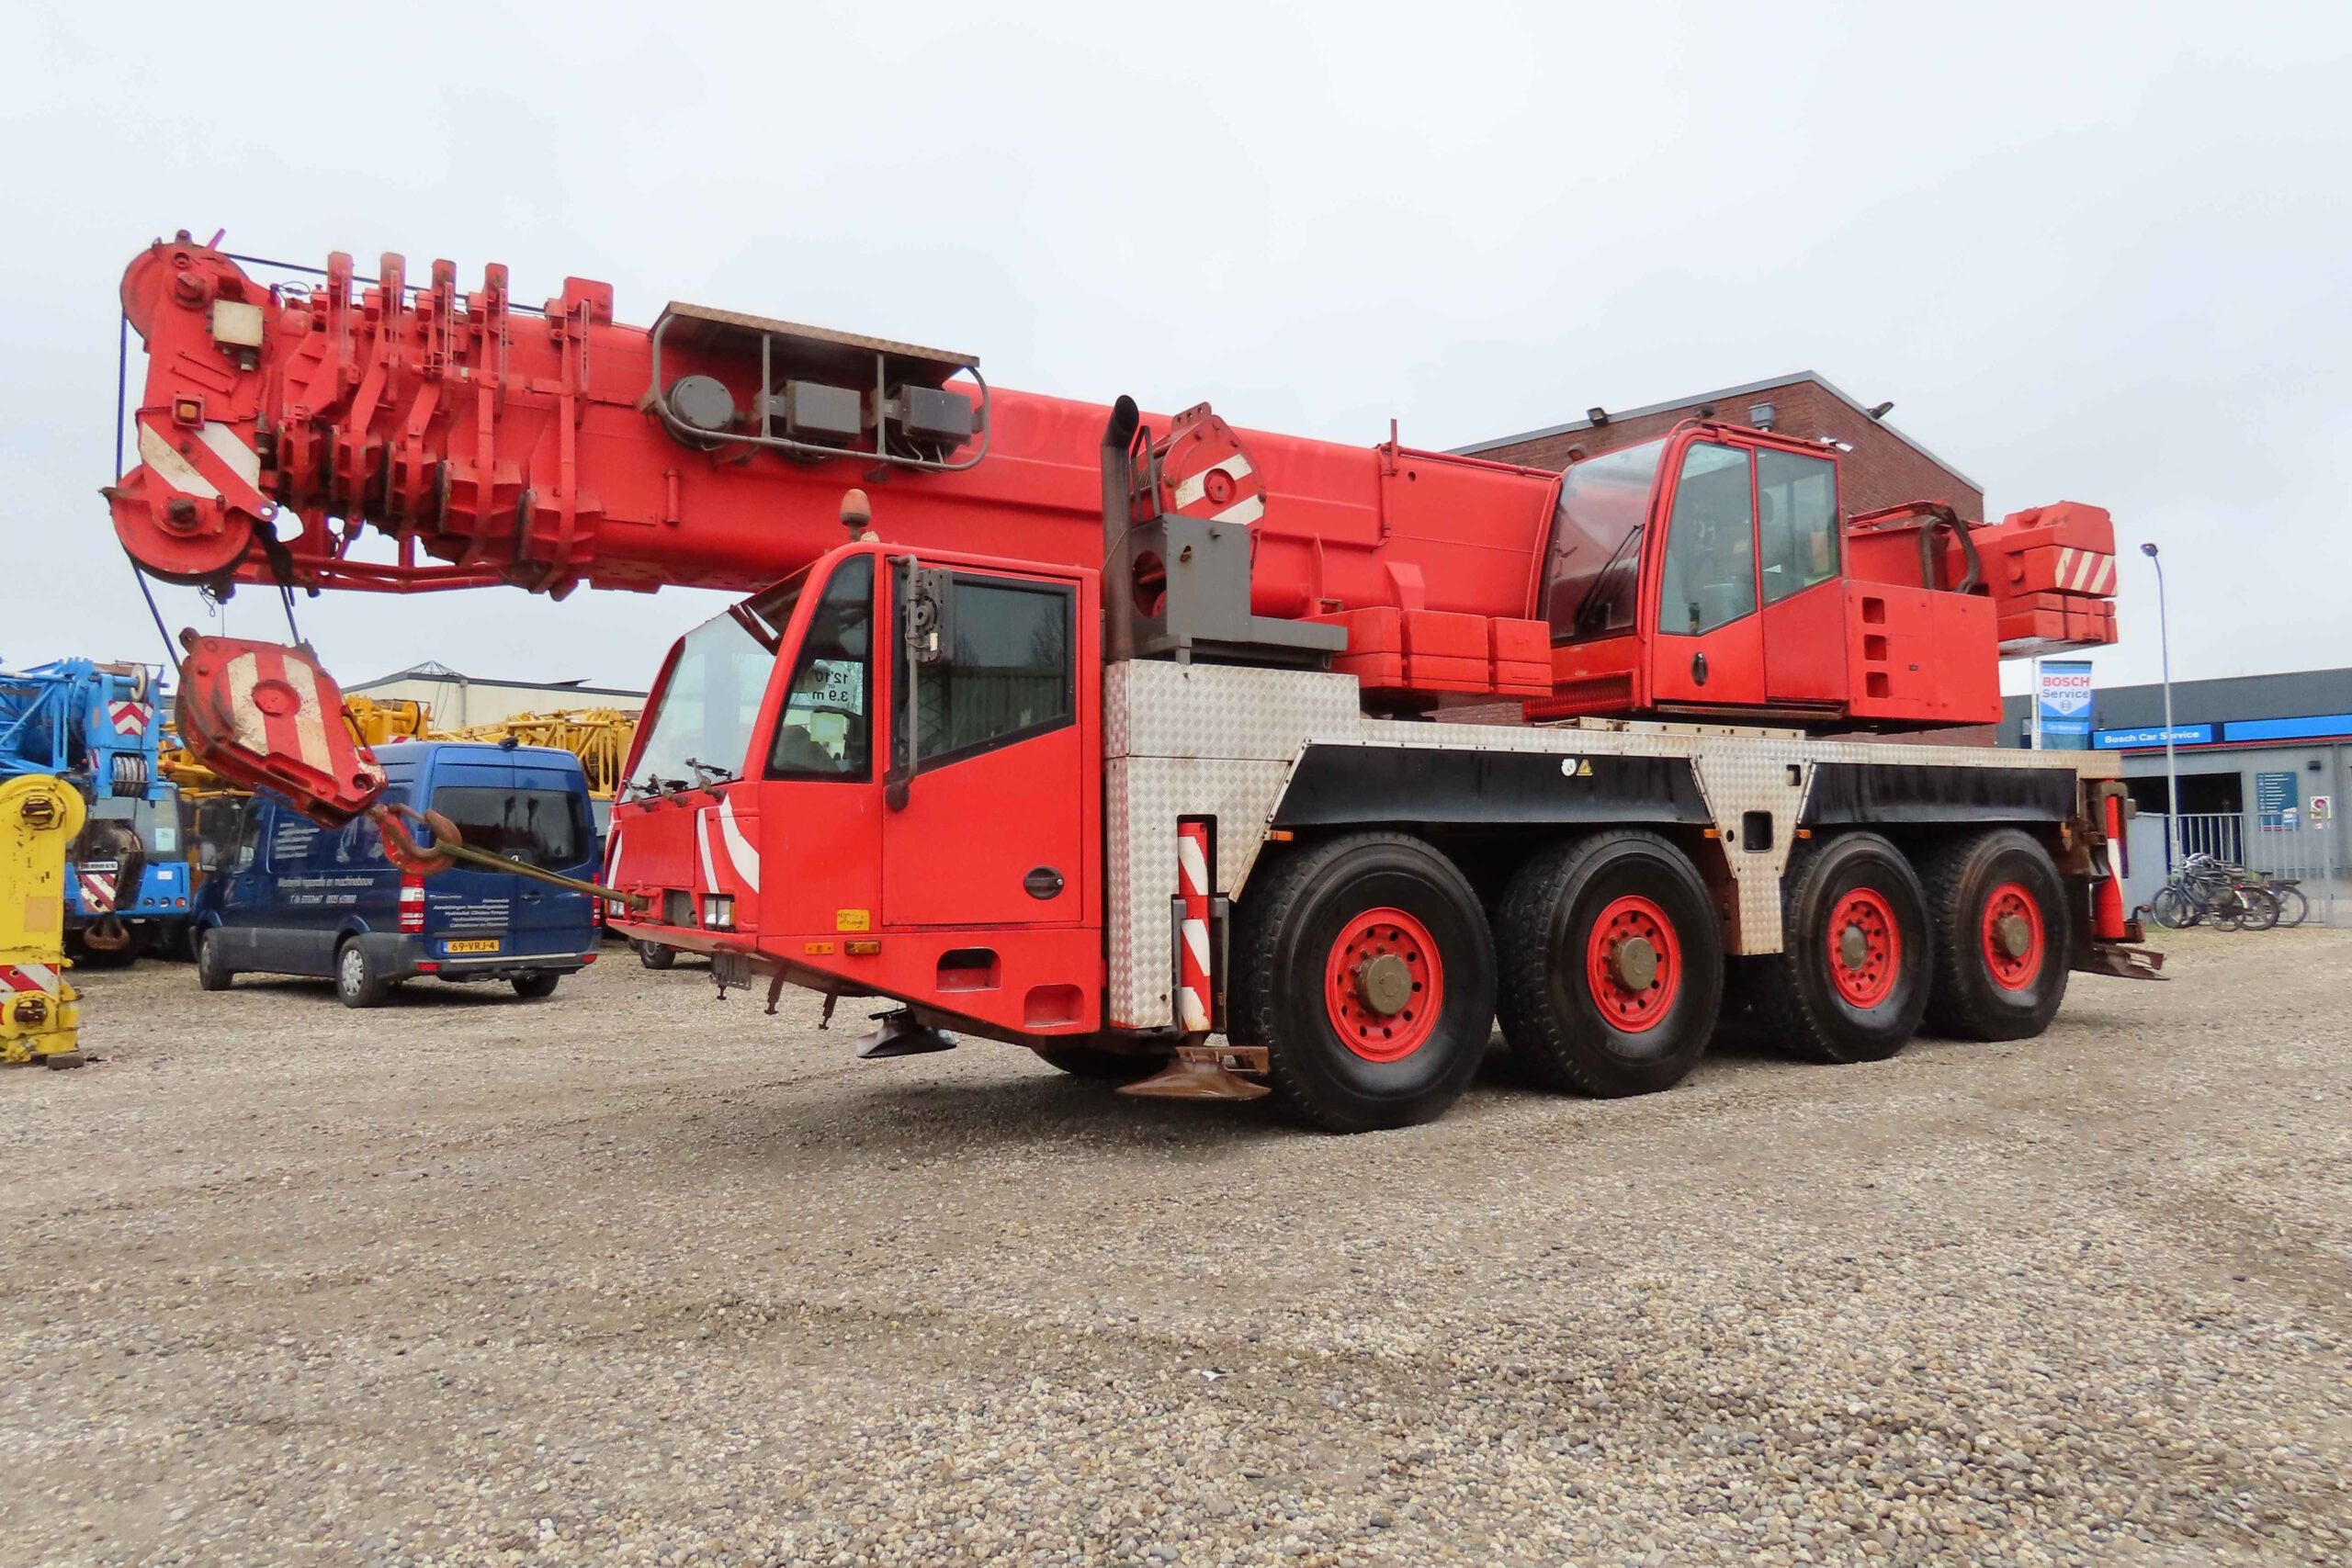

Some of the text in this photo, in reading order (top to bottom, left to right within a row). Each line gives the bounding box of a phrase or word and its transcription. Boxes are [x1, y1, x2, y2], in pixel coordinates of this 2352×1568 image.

[2042, 677, 2089, 687] BOSCH
[2042, 689, 2089, 698] Service
[2104, 734, 2136, 744] Bosch
[2138, 733, 2157, 741] Car
[452, 942, 495, 951] 69-VRJ-4
